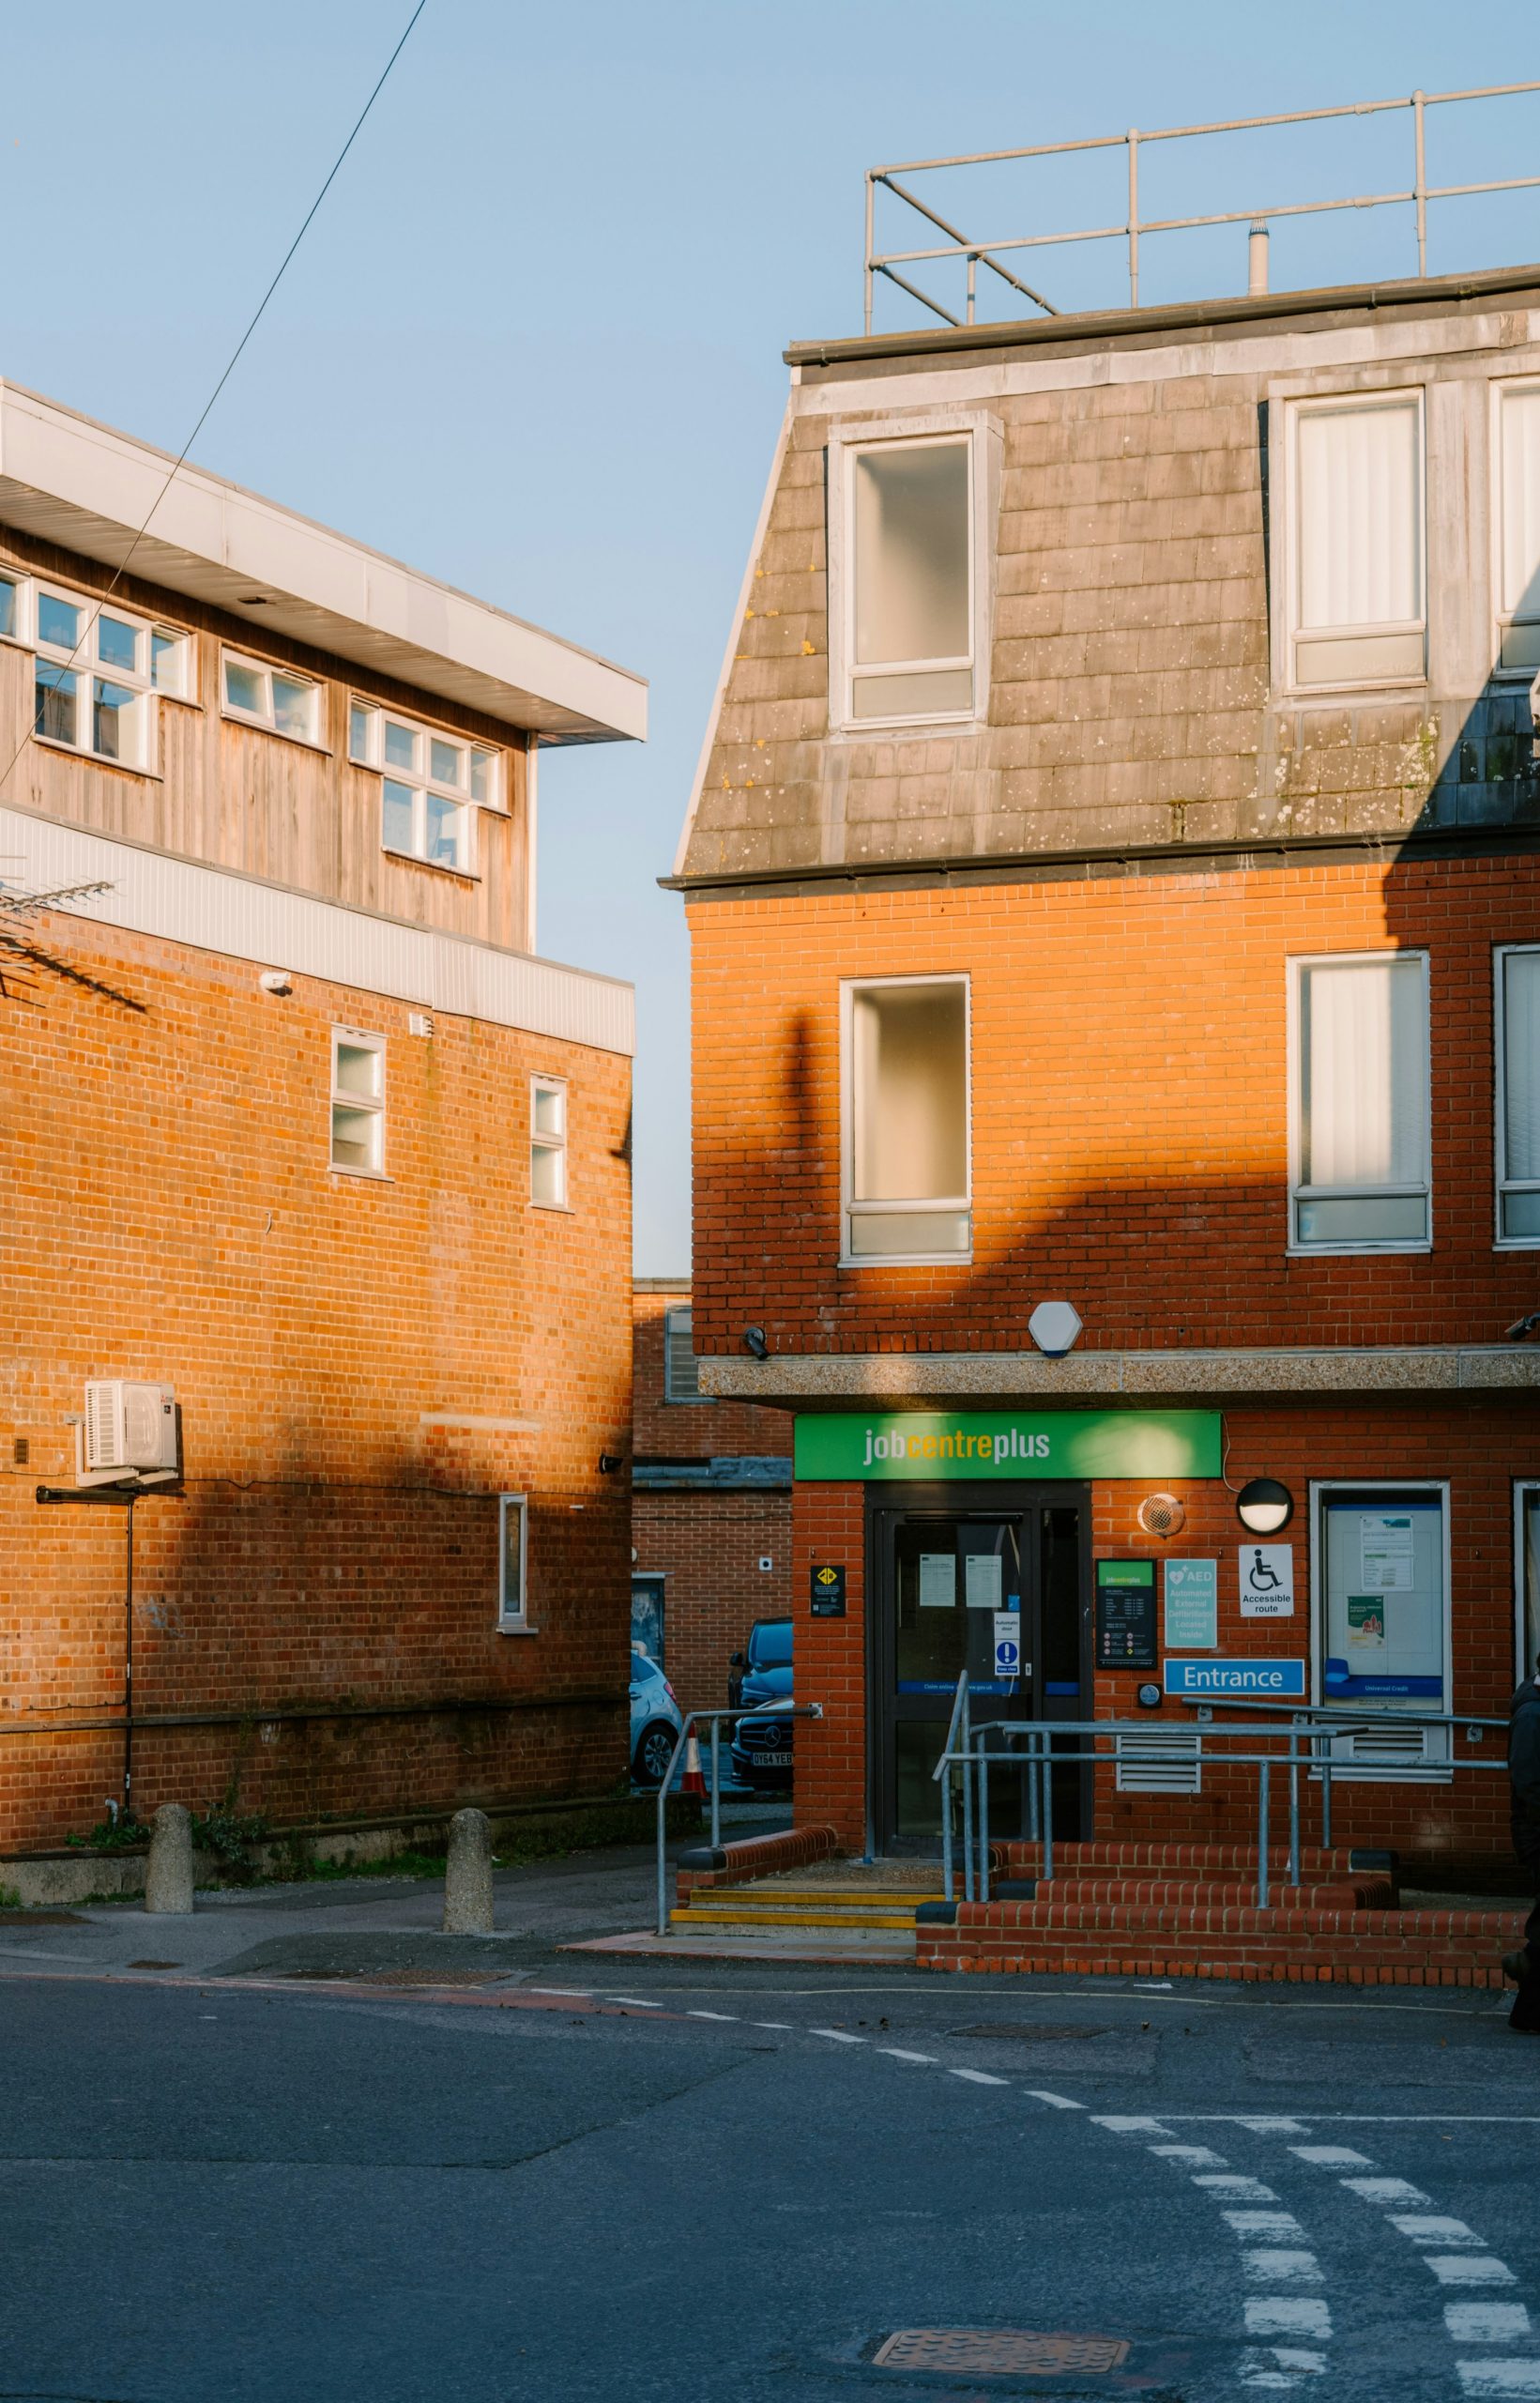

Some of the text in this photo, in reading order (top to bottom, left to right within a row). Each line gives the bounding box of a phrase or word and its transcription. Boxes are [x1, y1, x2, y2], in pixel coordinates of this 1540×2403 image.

[863, 1429, 1050, 1465] jobcentreplus
[1187, 1571, 1212, 1582] AED
[1169, 1589, 1212, 1598] Automated
[1184, 1666, 1283, 1688] Entrance
